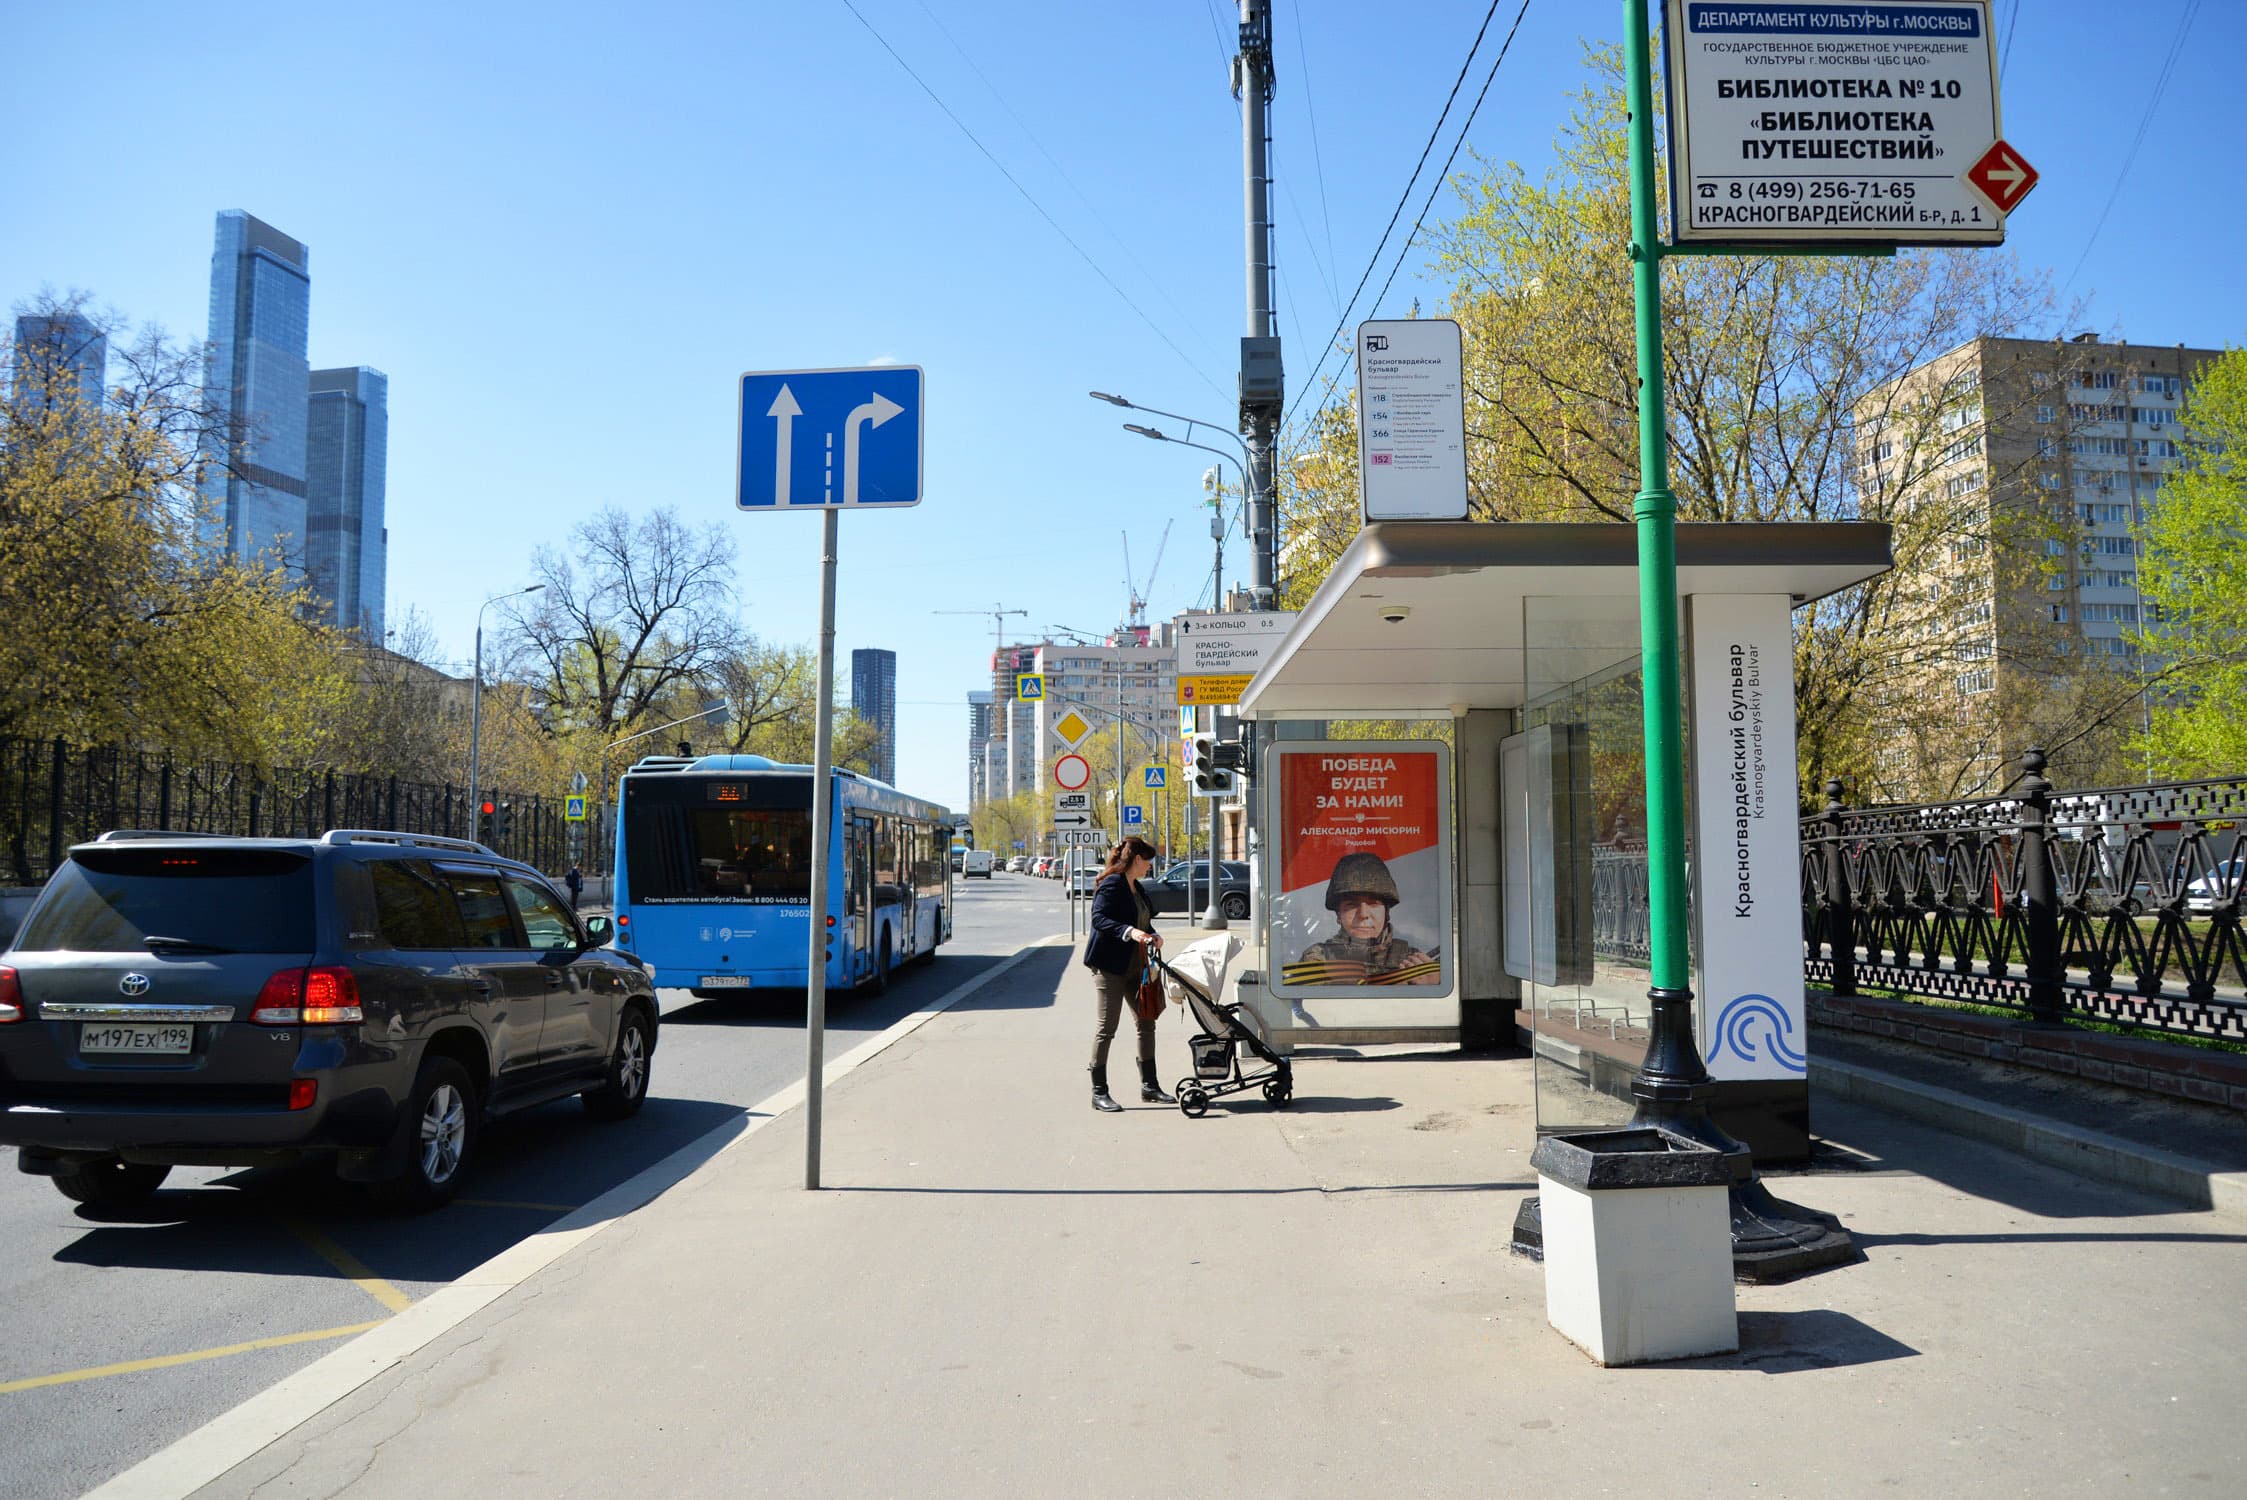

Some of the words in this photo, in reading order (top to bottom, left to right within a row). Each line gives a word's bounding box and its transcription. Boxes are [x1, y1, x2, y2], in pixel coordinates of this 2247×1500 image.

[1698, 12, 1806, 28] ДЕПАРТАМЕНТ
[1810, 13, 1889, 29] КУЛЬТУРЫ
[1893, 15, 1972, 30] г.МОСКВЫ
[1703, 42, 1814, 53] ГОСУДАРСТВЕННОЕ
[1817, 43, 1890, 54] БЮДЖЕТНОЕ
[1893, 43, 1969, 54] УЧРЕЖДЕНИЕ
[1745, 56, 1805, 65] КУЛЬТУРЫ
[1718, 79, 1892, 99] БИБЛИОТЕКА
[1899, 79, 1925, 98] №
[1931, 80, 1961, 99] 10
[1750, 112, 1934, 131] «БИБЛИОТЕКА
[1742, 134, 1944, 159] ПУТЕШЕСТВИЙ»
[1729, 182, 1743, 199] 8
[1748, 182, 1804, 202] (499)
[1810, 182, 1916, 199] 256-71-65
[1699, 201, 1915, 224] КРАСНОГВАРДЕЙСКИЙ
[1970, 205, 1982, 222] 1
[1368, 358, 1441, 366] Красногвардейский
[1368, 366, 1399, 374] бульвар
[1372, 430, 1389, 438] 366
[1374, 455, 1389, 464] 152
[1195, 622, 1207, 630] 3-е
[1209, 620, 1246, 629] КОЛЬЦО
[1195, 641, 1233, 649] КРАСНО-
[1195, 649, 1258, 659] ГВАРДЕЙСКИЙ
[1195, 659, 1231, 668] бульвар
[1747, 644, 1760, 687] Bulvar
[1728, 644, 1748, 721] бульвар
[1749, 691, 1766, 819] Krasnogvardeyskiy
[1322, 758, 1397, 773] ПОБЕДА
[1331, 777, 1388, 792] БУДЕТ
[1316, 796, 1340, 809] ЗА
[1345, 795, 1404, 808] НАМИ!
[1128, 807, 1139, 822] P
[1729, 727, 1754, 917] Красногвардейский
[1065, 832, 1100, 844] СТОП
[1301, 826, 1364, 837] АЛЕКСАНДР
[1366, 826, 1420, 836] МИСЮРИН
[799, 896, 808, 904] 20
[86, 1029, 157, 1048] М197ЕХ
[160, 1028, 188, 1043] 199
[270, 1032, 291, 1041] V8
